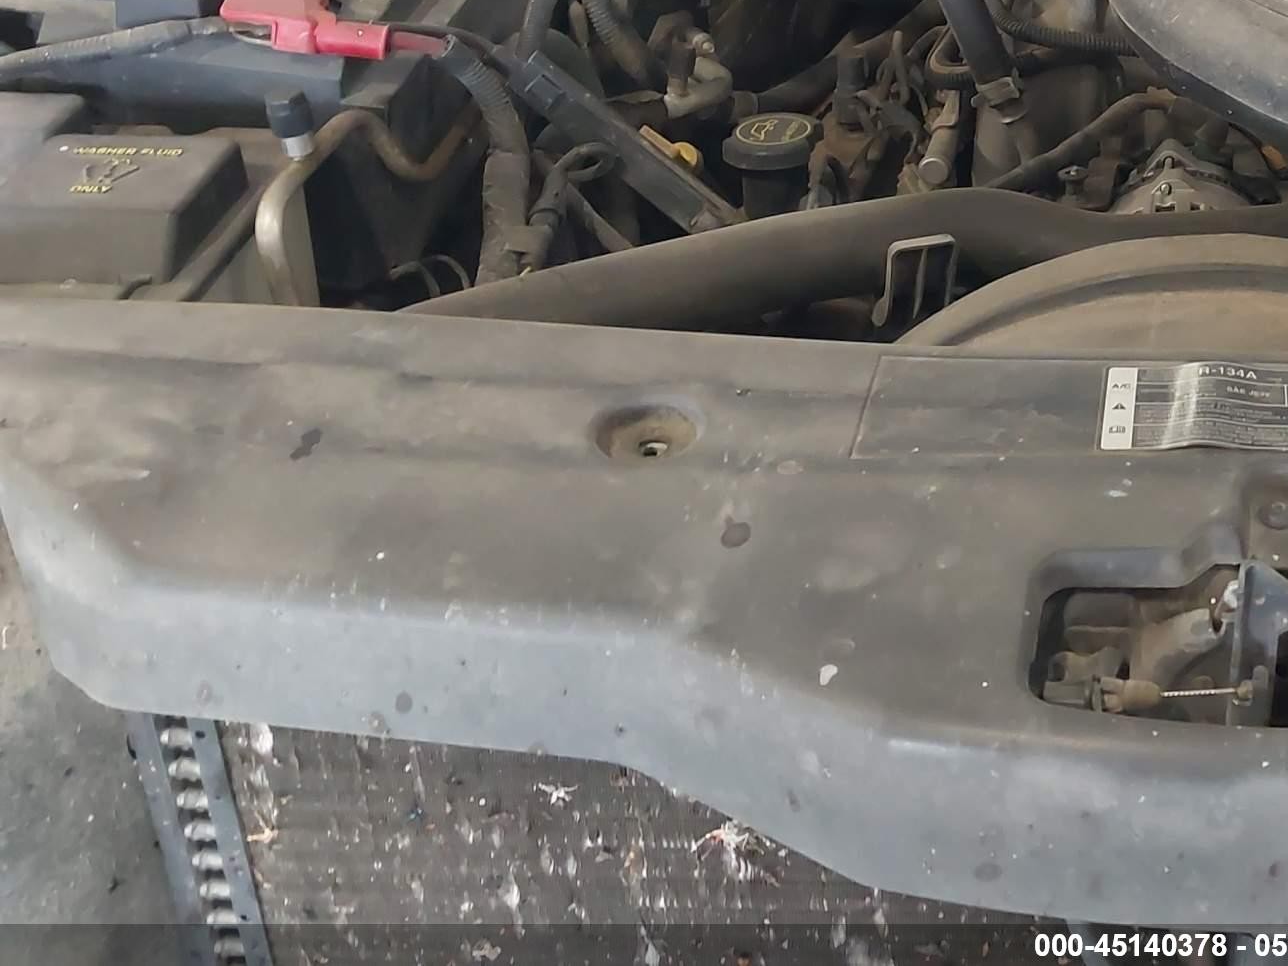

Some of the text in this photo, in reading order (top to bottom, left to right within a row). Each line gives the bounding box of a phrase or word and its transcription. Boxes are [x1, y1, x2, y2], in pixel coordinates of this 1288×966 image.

[73, 145, 185, 157] WASHER FLUID
[69, 184, 113, 195] ONLY
[1198, 365, 1258, 381] R-134A
